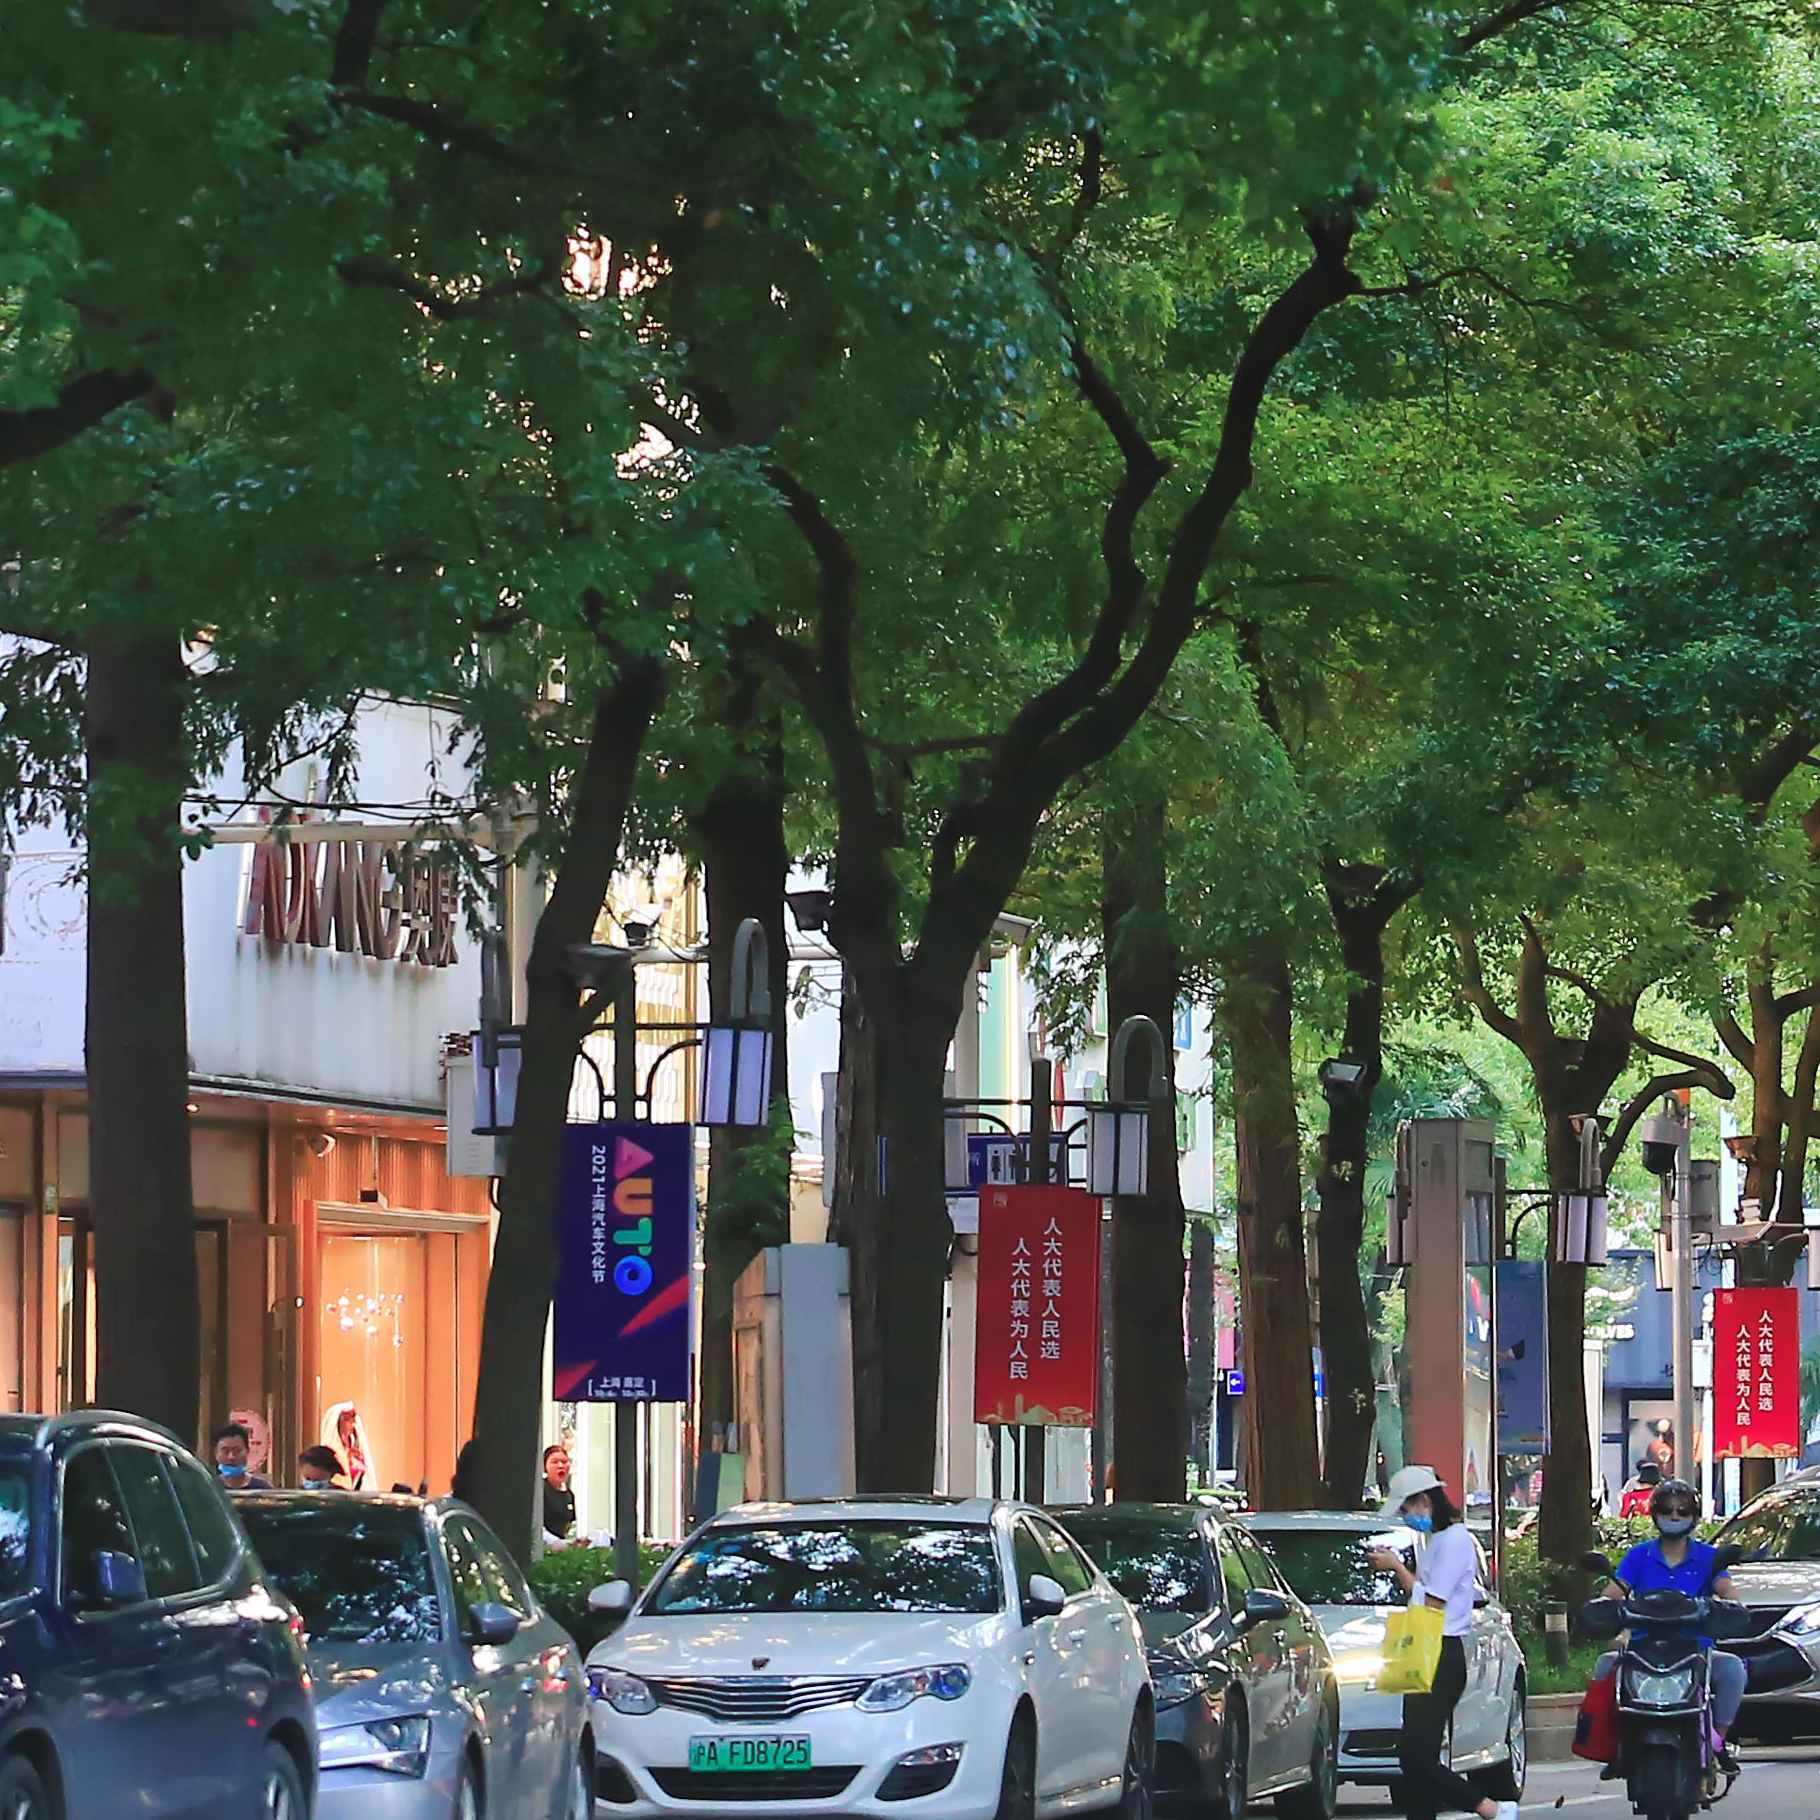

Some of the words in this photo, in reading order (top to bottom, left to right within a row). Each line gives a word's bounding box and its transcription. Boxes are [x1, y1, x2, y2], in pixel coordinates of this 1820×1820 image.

[613, 1136, 655, 1296] AUTO
[1009, 1237, 1031, 1379] 人大代表为人民
[1041, 1217, 1063, 1359] 人大代表人民选
[1736, 1324, 1751, 1425] 人大代表为人民
[1758, 1310, 1774, 1411] 人大代表人民选
[730, 1739, 808, 1765] FD8725
